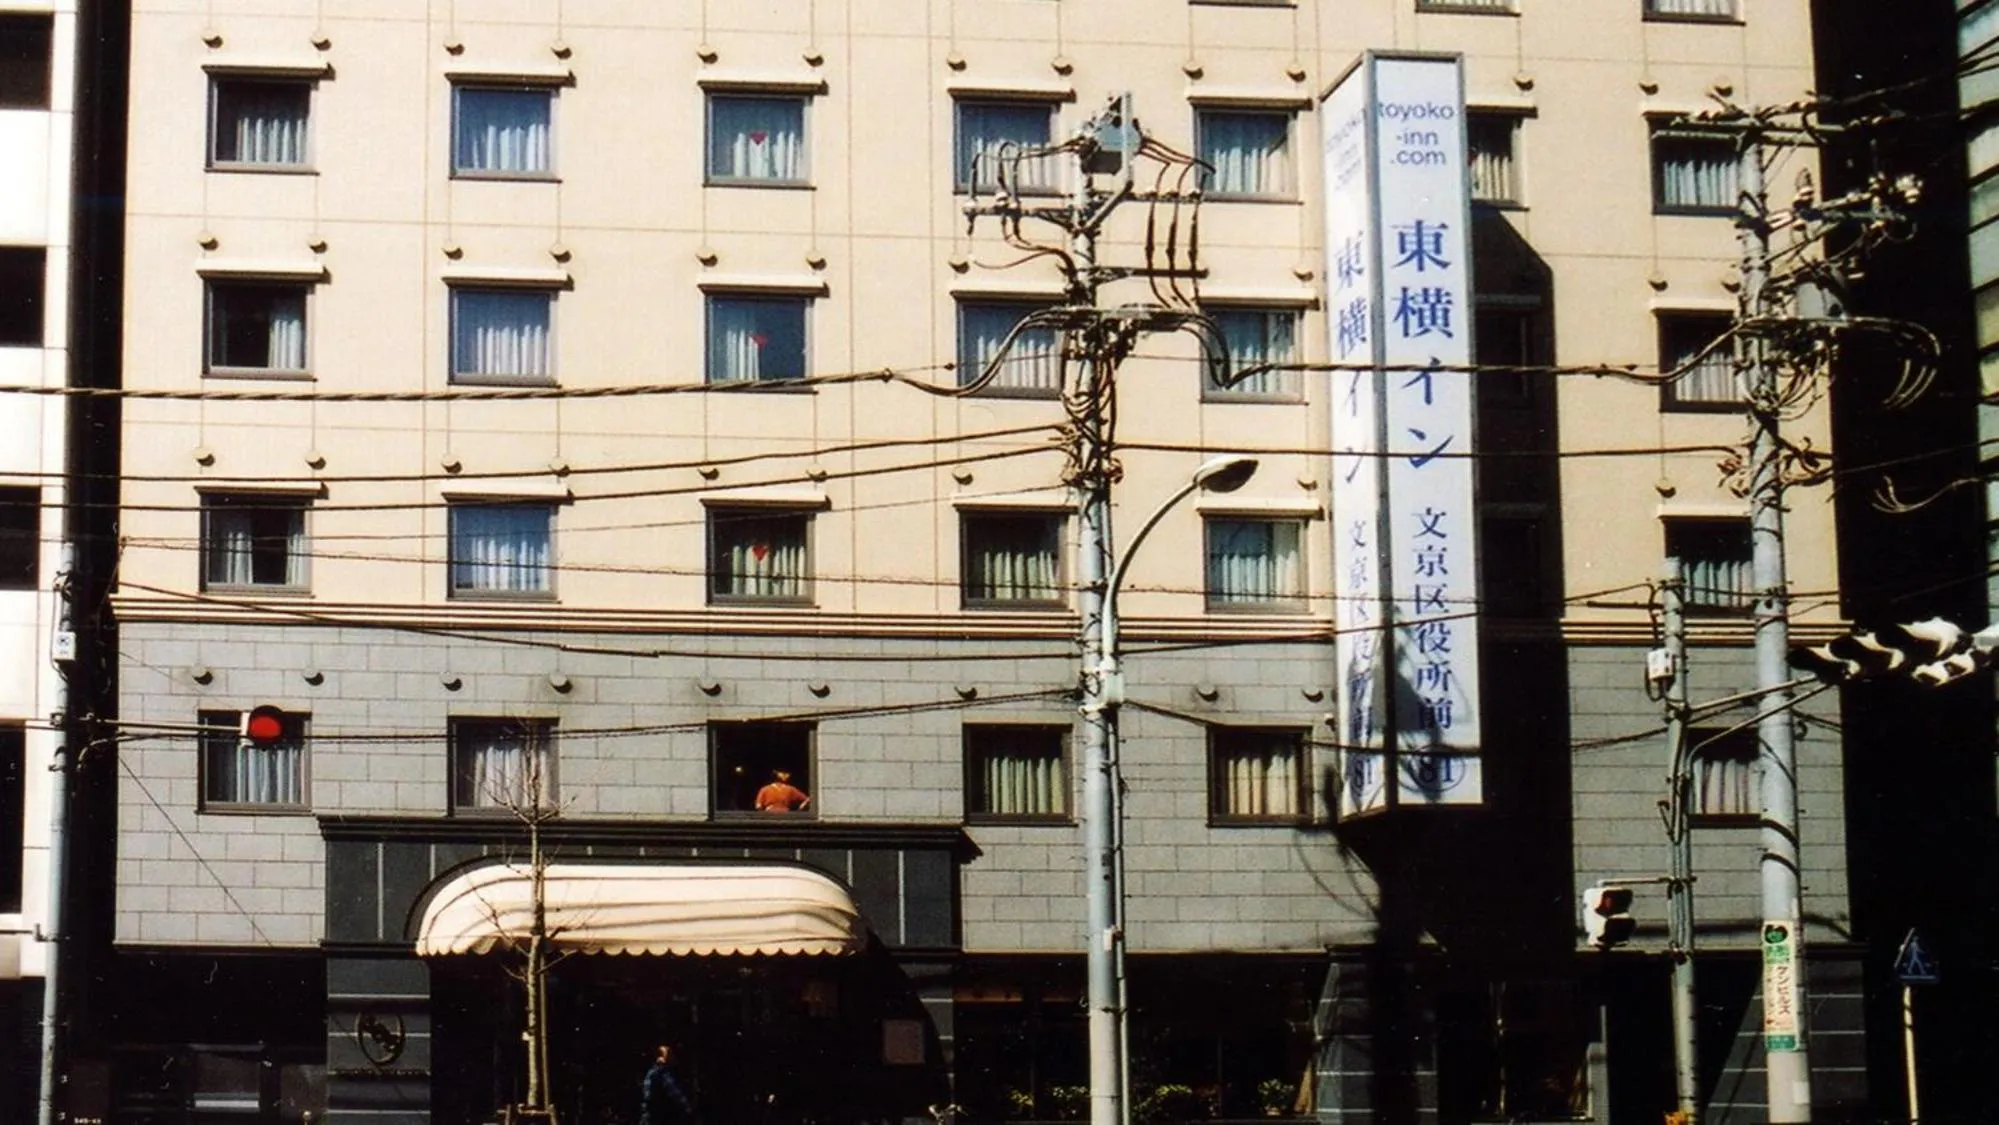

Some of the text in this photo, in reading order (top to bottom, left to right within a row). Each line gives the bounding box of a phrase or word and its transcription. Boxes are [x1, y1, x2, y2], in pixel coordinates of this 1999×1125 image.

[1377, 100, 1455, 122] toyoko
[1396, 128, 1439, 145] -inn
[1389, 148, 1447, 166] .com
[1389, 219, 1455, 731] 東横イン 文京区役所前
